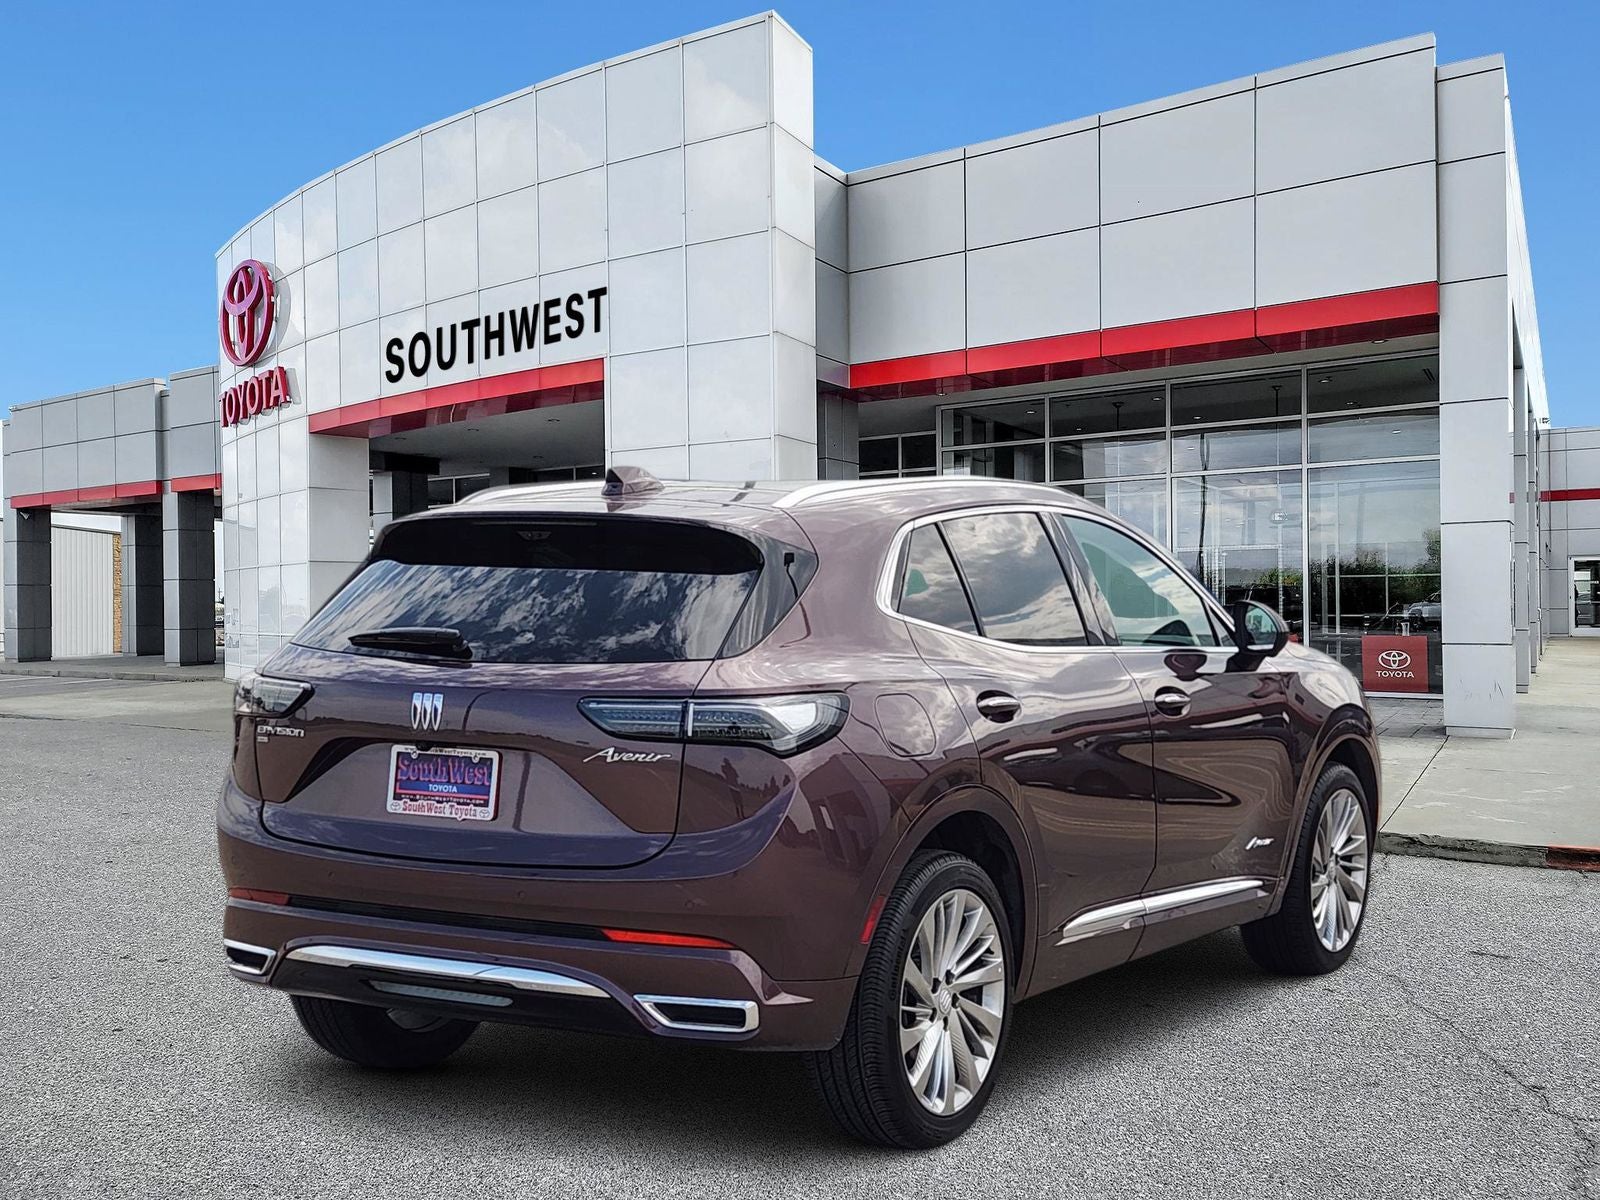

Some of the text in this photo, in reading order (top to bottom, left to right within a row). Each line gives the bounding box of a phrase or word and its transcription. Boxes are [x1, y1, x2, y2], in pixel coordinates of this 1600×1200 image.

[385, 286, 608, 384] SOUTHWEST
[219, 366, 290, 428] TOYOTA
[1375, 670, 1415, 678] TOYOTA
[583, 747, 672, 762] Avenir
[428, 784, 458, 793] TOYOTA
[402, 800, 477, 819] SouthWest Toyota
